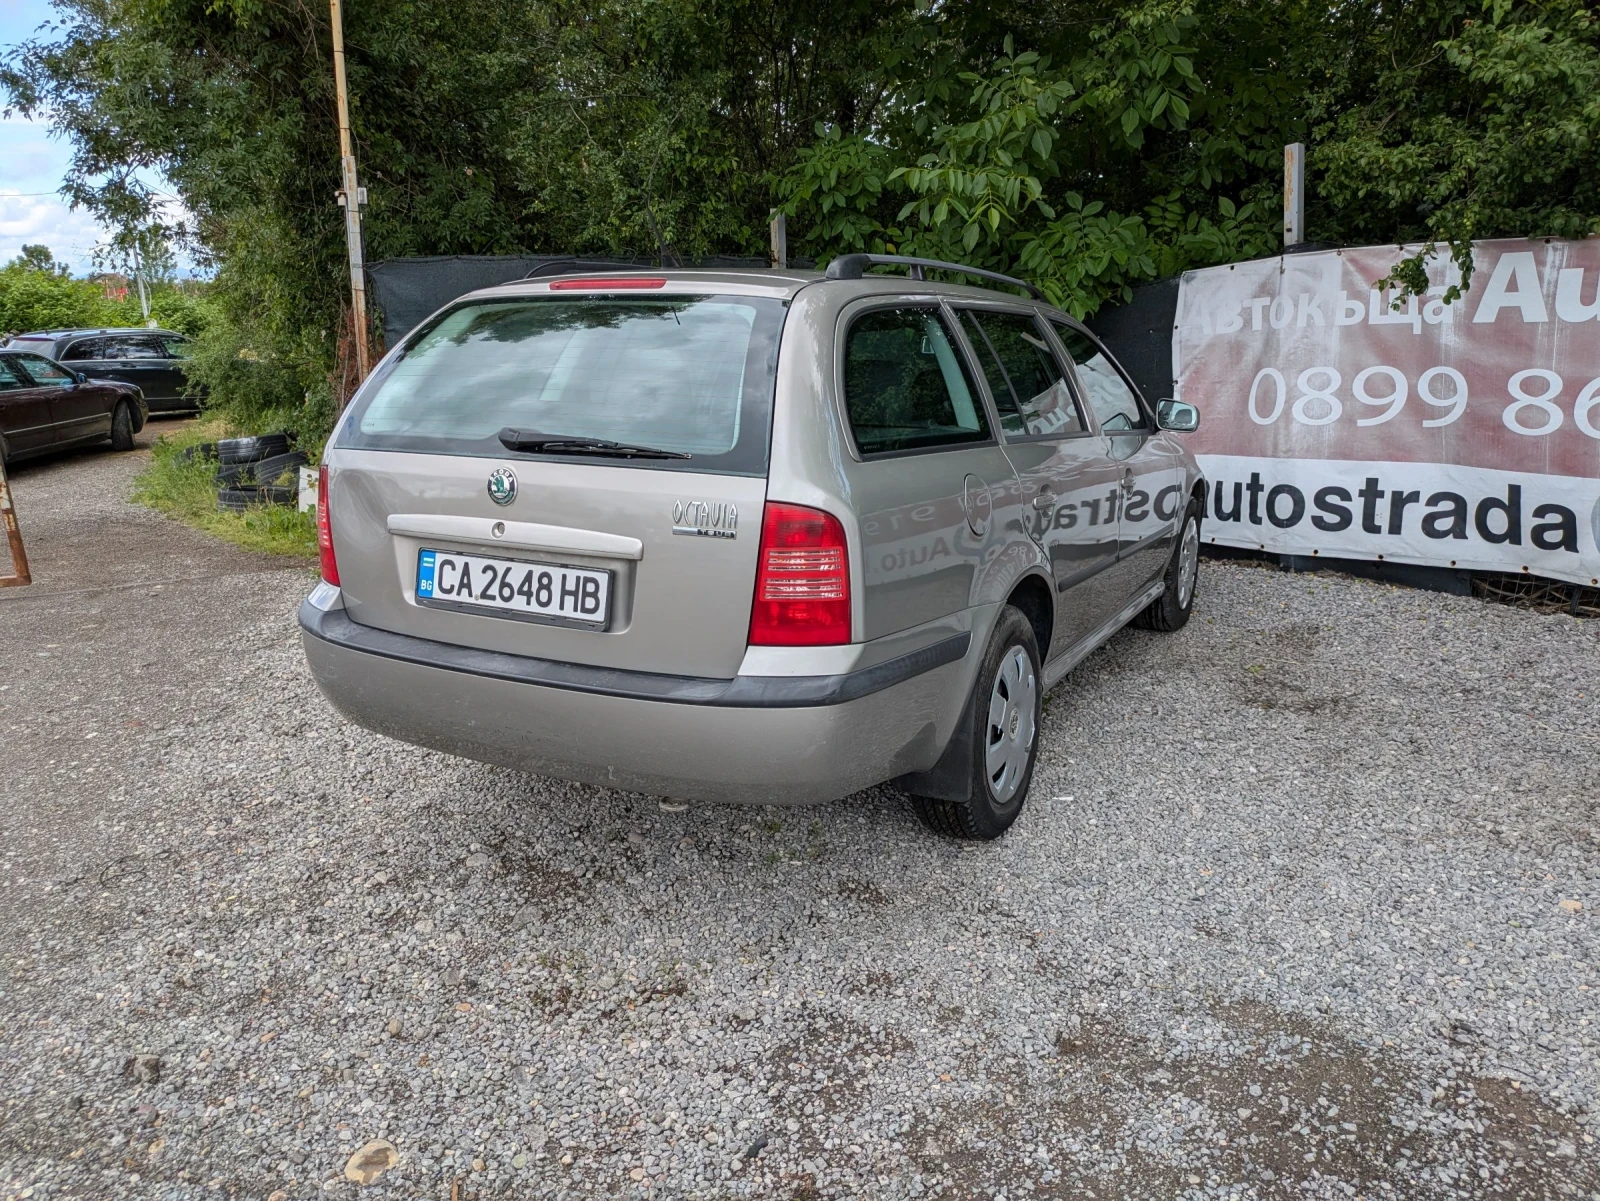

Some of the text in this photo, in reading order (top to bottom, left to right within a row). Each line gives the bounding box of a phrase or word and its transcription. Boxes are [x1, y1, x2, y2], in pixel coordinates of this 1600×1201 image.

[1248, 365, 1469, 428] 0899
[672, 499, 738, 529] OCTAVIA
[421, 579, 432, 591] BG
[437, 559, 601, 615] CA 2648 HB
